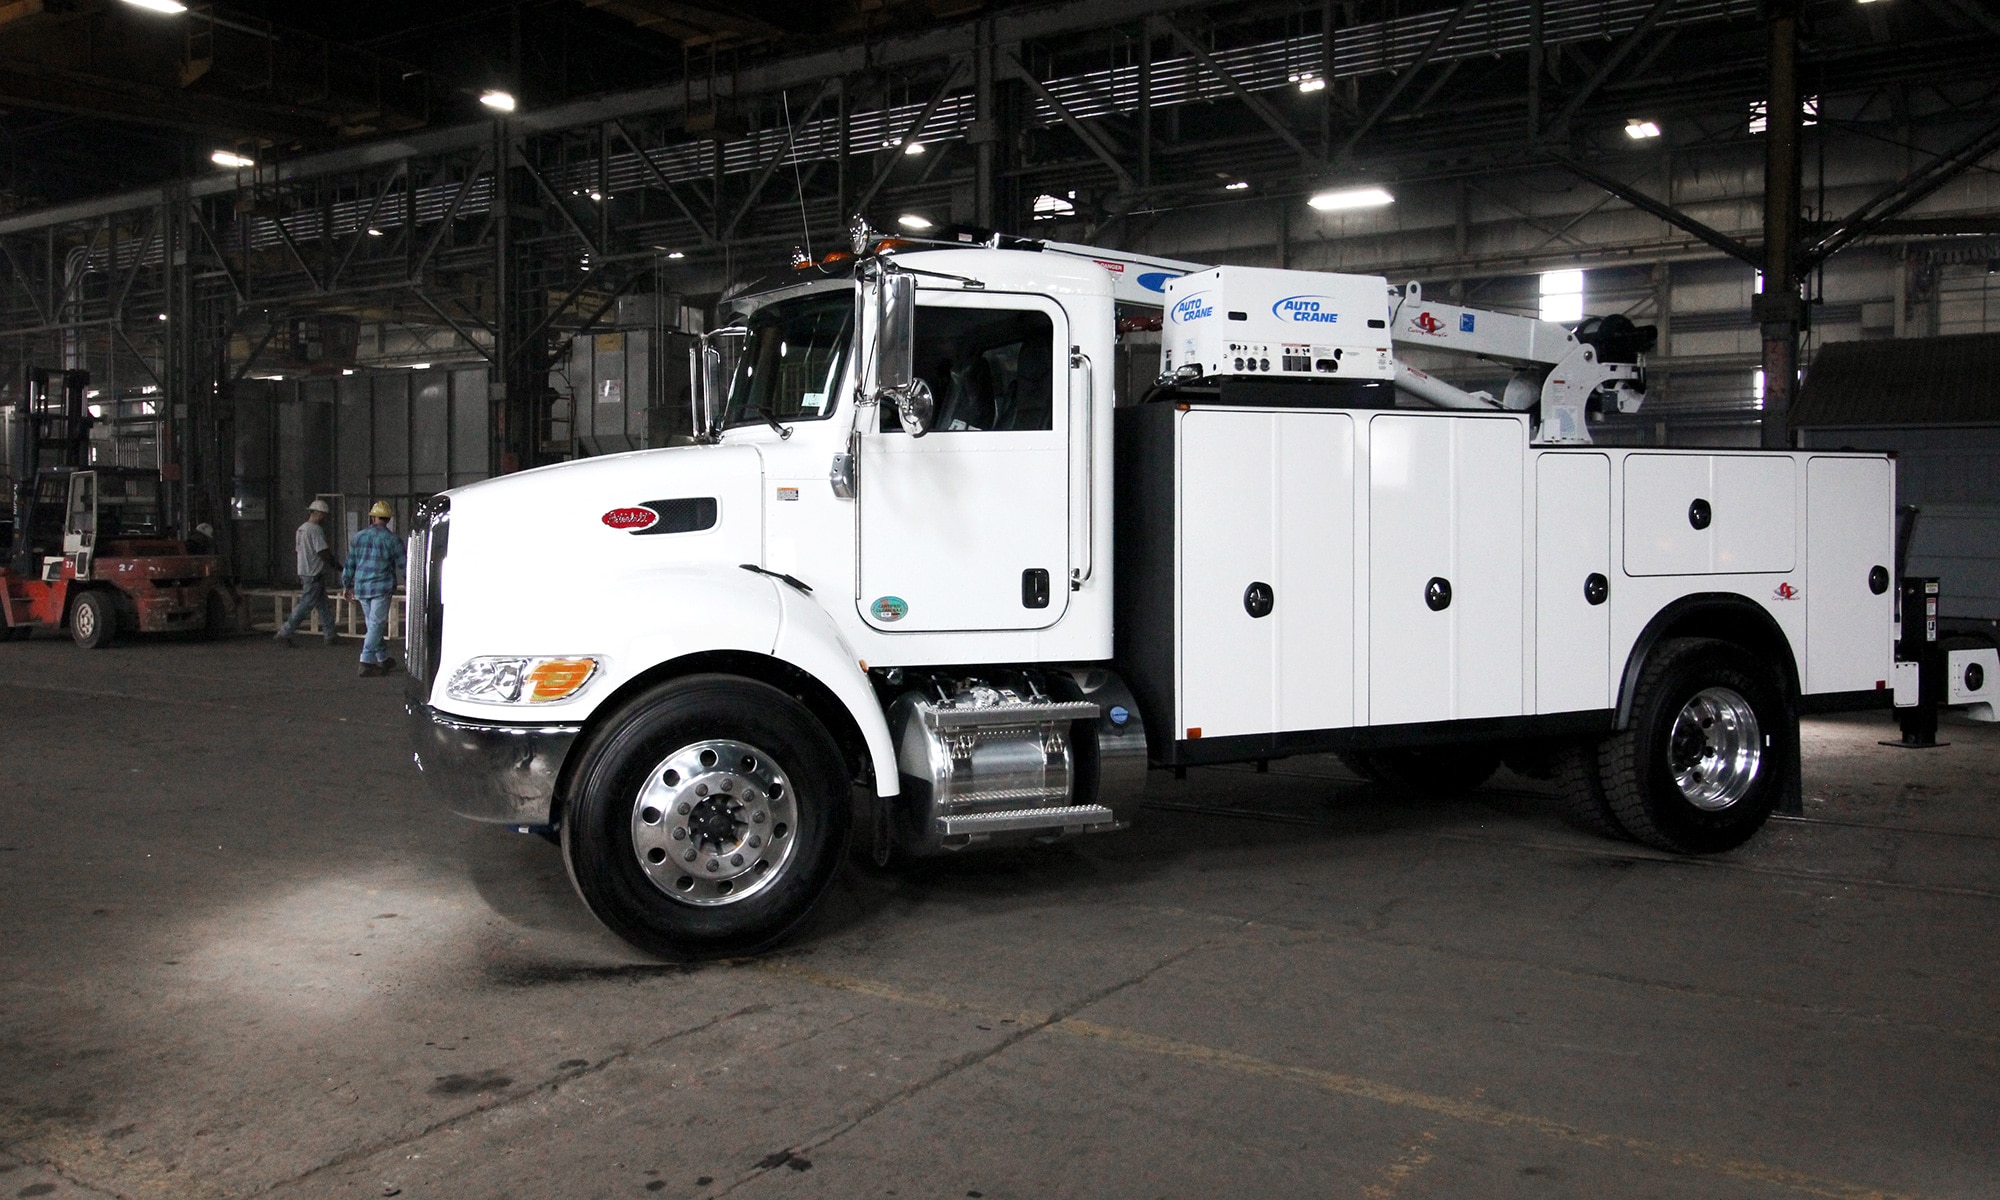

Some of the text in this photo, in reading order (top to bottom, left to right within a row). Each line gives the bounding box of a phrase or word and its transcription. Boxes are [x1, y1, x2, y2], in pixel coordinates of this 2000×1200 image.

[1178, 299, 1202, 312] AUTO
[1284, 301, 1320, 312] AUTO
[1183, 306, 1213, 321] CRANE
[1293, 312, 1338, 323] CRANE
[66, 560, 74, 569] 27
